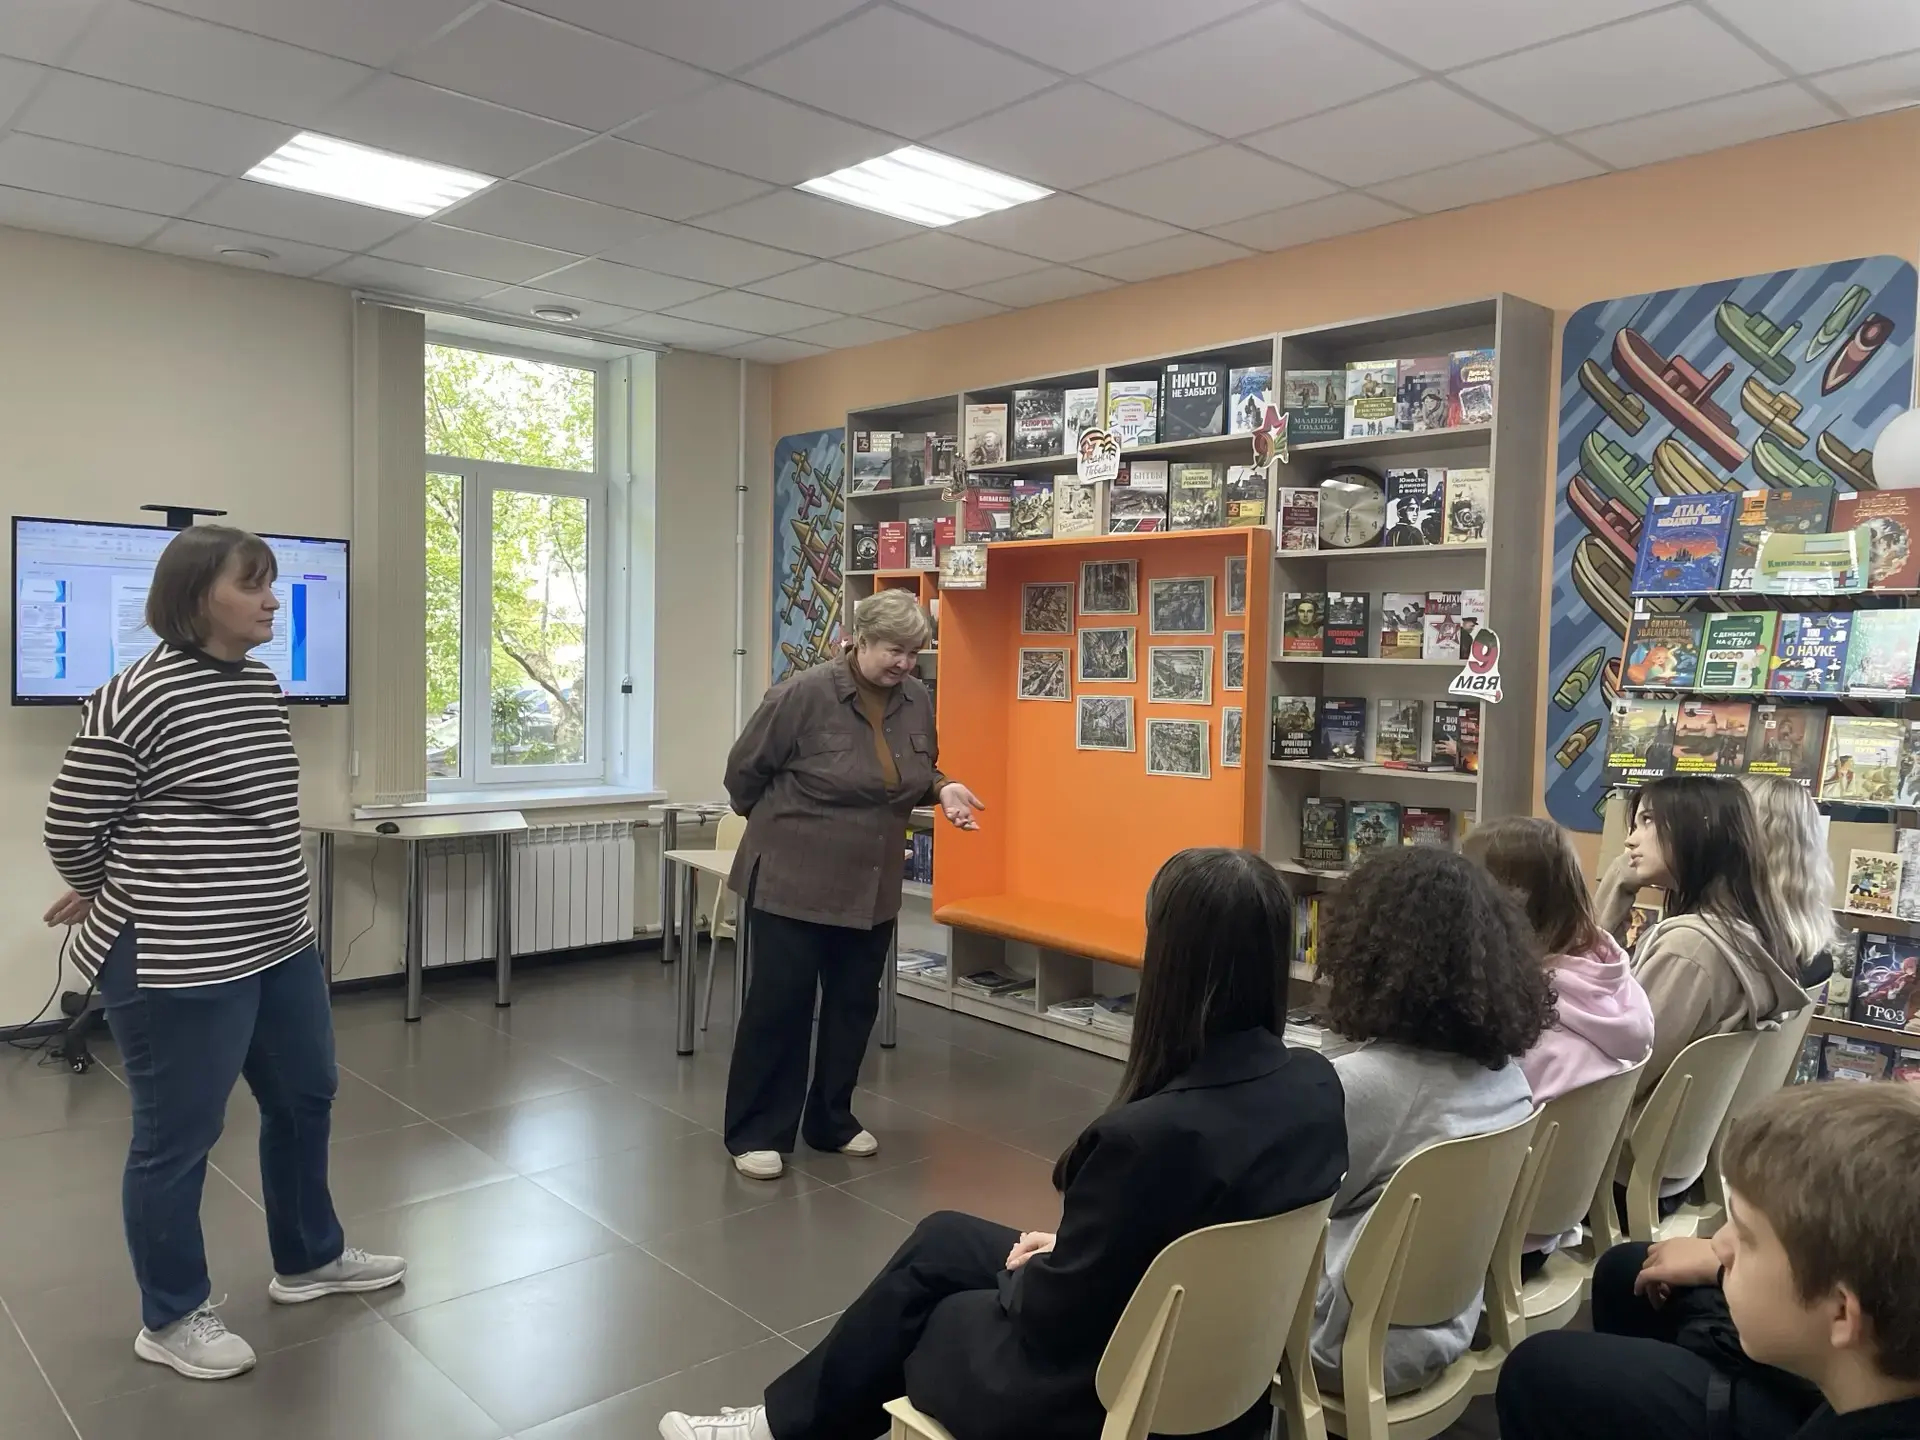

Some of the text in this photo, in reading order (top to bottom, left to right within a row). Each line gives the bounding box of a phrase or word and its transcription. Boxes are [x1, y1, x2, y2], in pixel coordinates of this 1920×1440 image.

[1172, 371, 1217, 389] НИЧТО
[1172, 387, 1217, 399] НЕ ЗАБЫТО
[1021, 419, 1054, 427] РЕПОРТАЖ
[1134, 471, 1164, 480] БИТВЫ
[1373, 491, 1379, 500] 2
[1672, 504, 1711, 518] АТЛАС
[1372, 521, 1378, 529] 4
[1701, 515, 1722, 525] НЕБА
[1329, 532, 1336, 541] 7
[1468, 629, 1499, 674] 9
[1786, 645, 1837, 657] О НАУКЕ
[1456, 675, 1501, 691] мая
[1443, 724, 1456, 732] СВО
[1628, 768, 1664, 776] КОМИКСАХ
[1866, 1004, 1905, 1023] ГРОЗ
